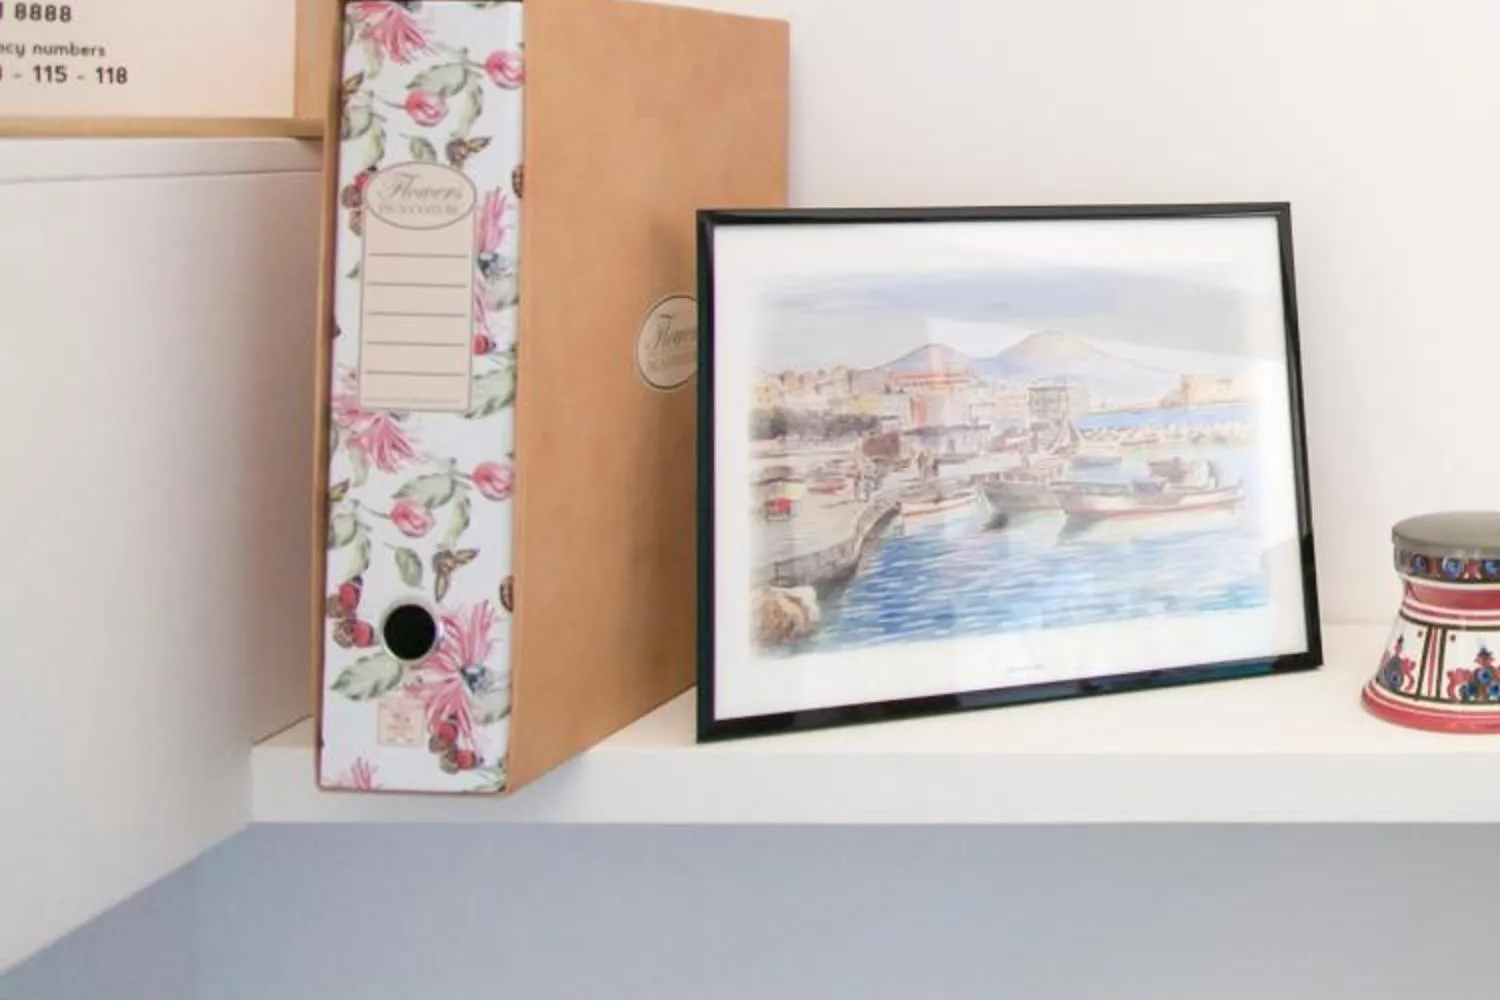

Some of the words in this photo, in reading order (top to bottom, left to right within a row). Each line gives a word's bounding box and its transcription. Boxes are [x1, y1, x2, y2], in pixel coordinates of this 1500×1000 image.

[14, 1, 72, 23] 8888
[33, 41, 106, 58] numbers
[33, 64, 68, 83] 115
[95, 66, 128, 85] 118
